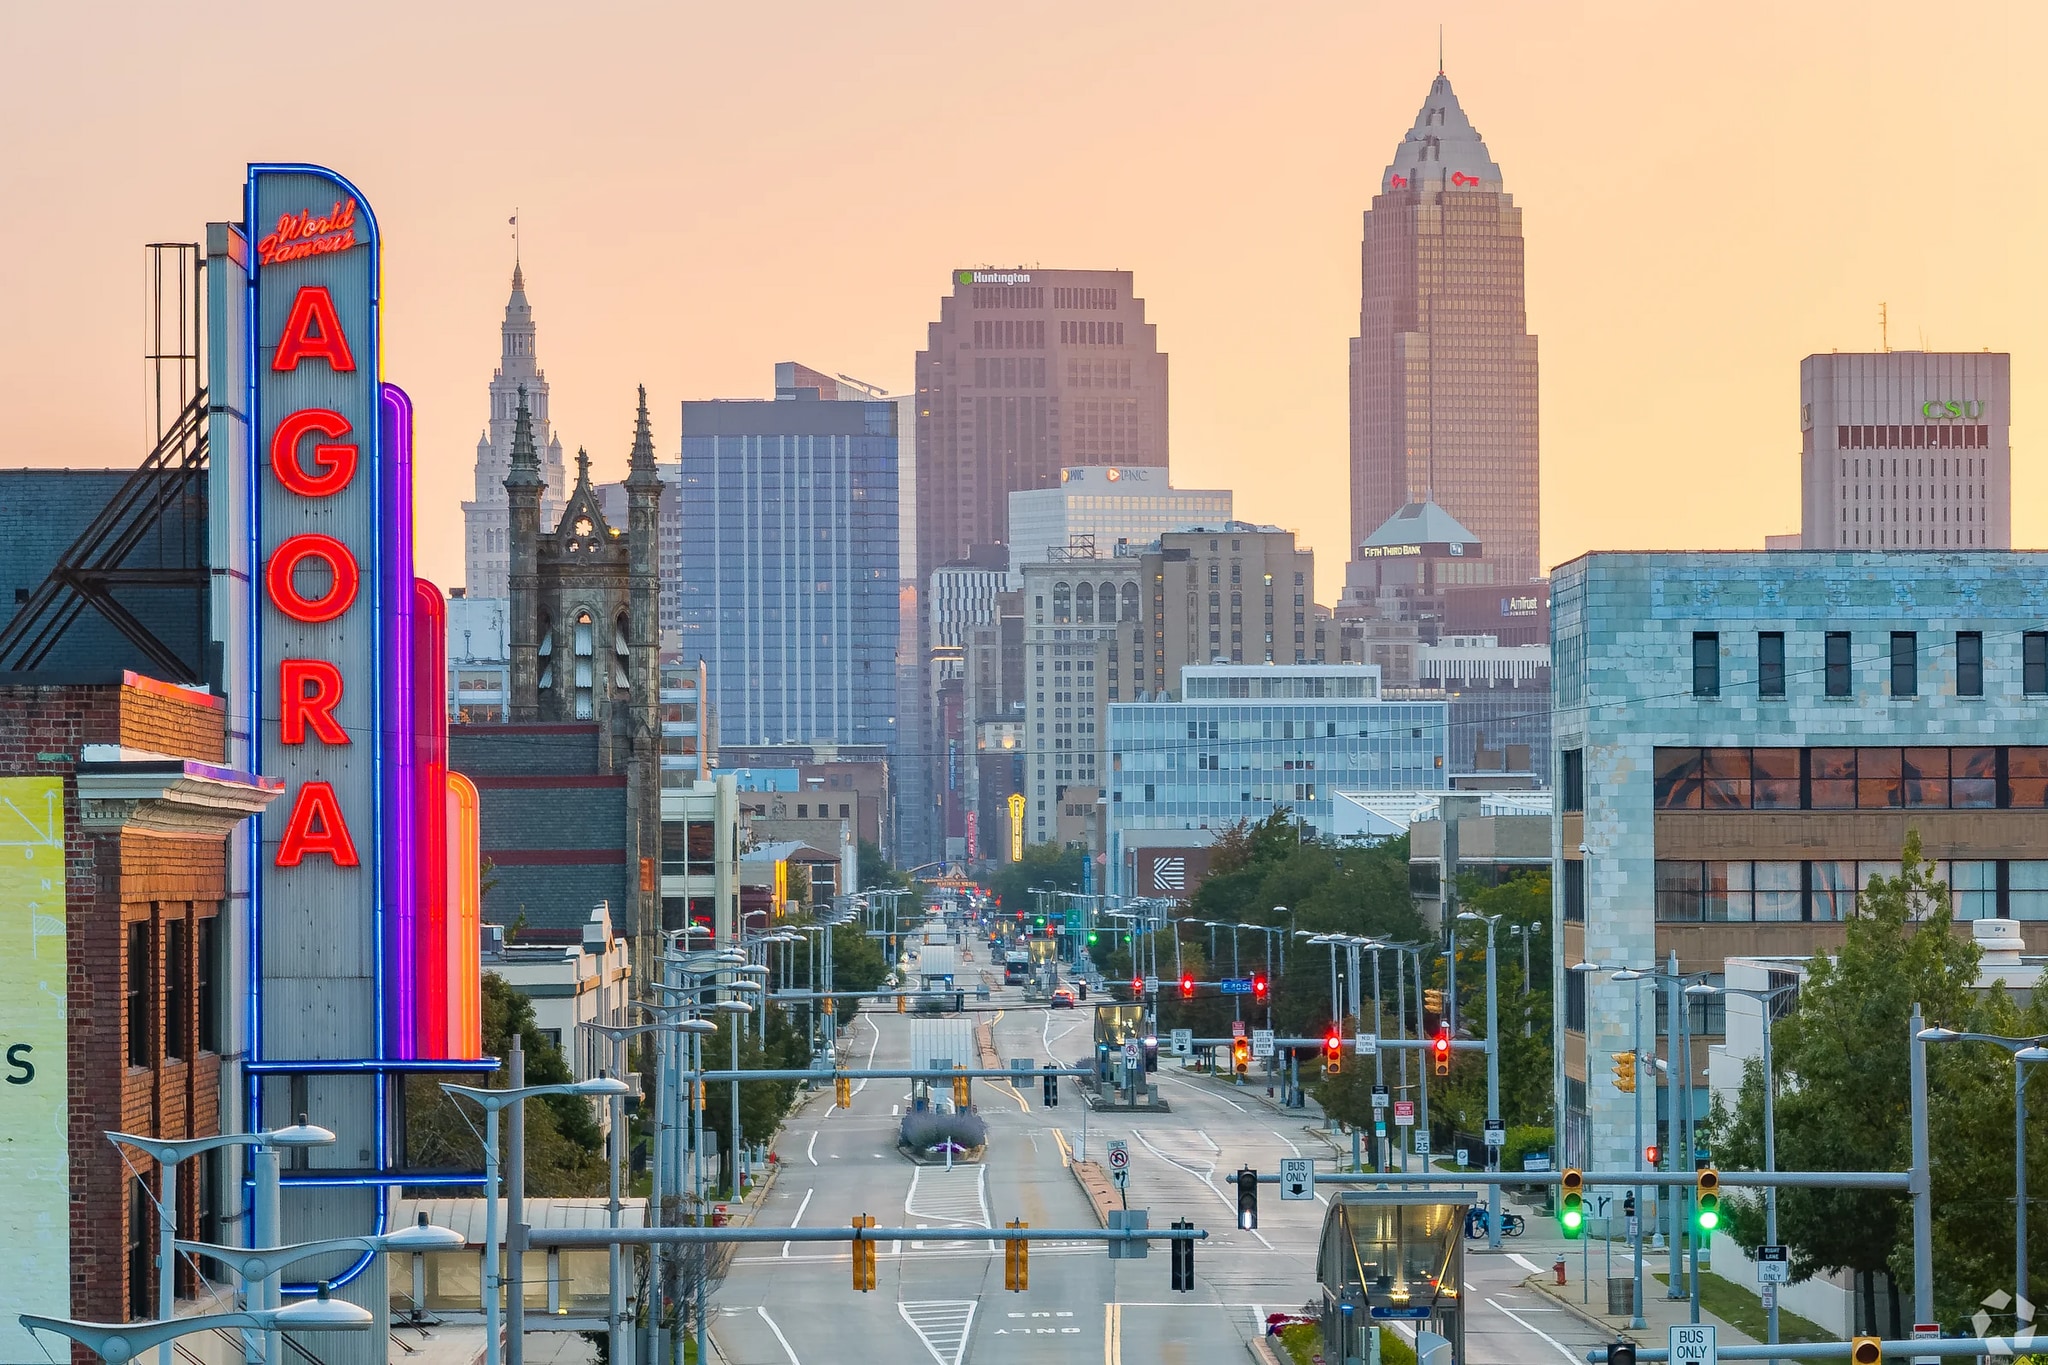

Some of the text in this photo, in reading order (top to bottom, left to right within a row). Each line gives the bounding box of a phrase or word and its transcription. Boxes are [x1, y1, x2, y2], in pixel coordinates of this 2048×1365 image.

[278, 198, 356, 243] World
[257, 229, 357, 267] Famous
[973, 272, 1031, 286] Huntington
[1922, 400, 1984, 420] CSU
[1120, 469, 1150, 482] PNC
[267, 286, 360, 868] AGORA
[1510, 597, 1538, 610] AmTrust
[5, 1043, 36, 1085] S
[1416, 1142, 1429, 1152] 25
[1287, 1161, 1306, 1171] BUS
[1285, 1172, 1308, 1182] ONLY
[1763, 1273, 1781, 1281] ONLY
[1679, 1330, 1704, 1344] BUS
[1676, 1345, 1708, 1359] ONLY
